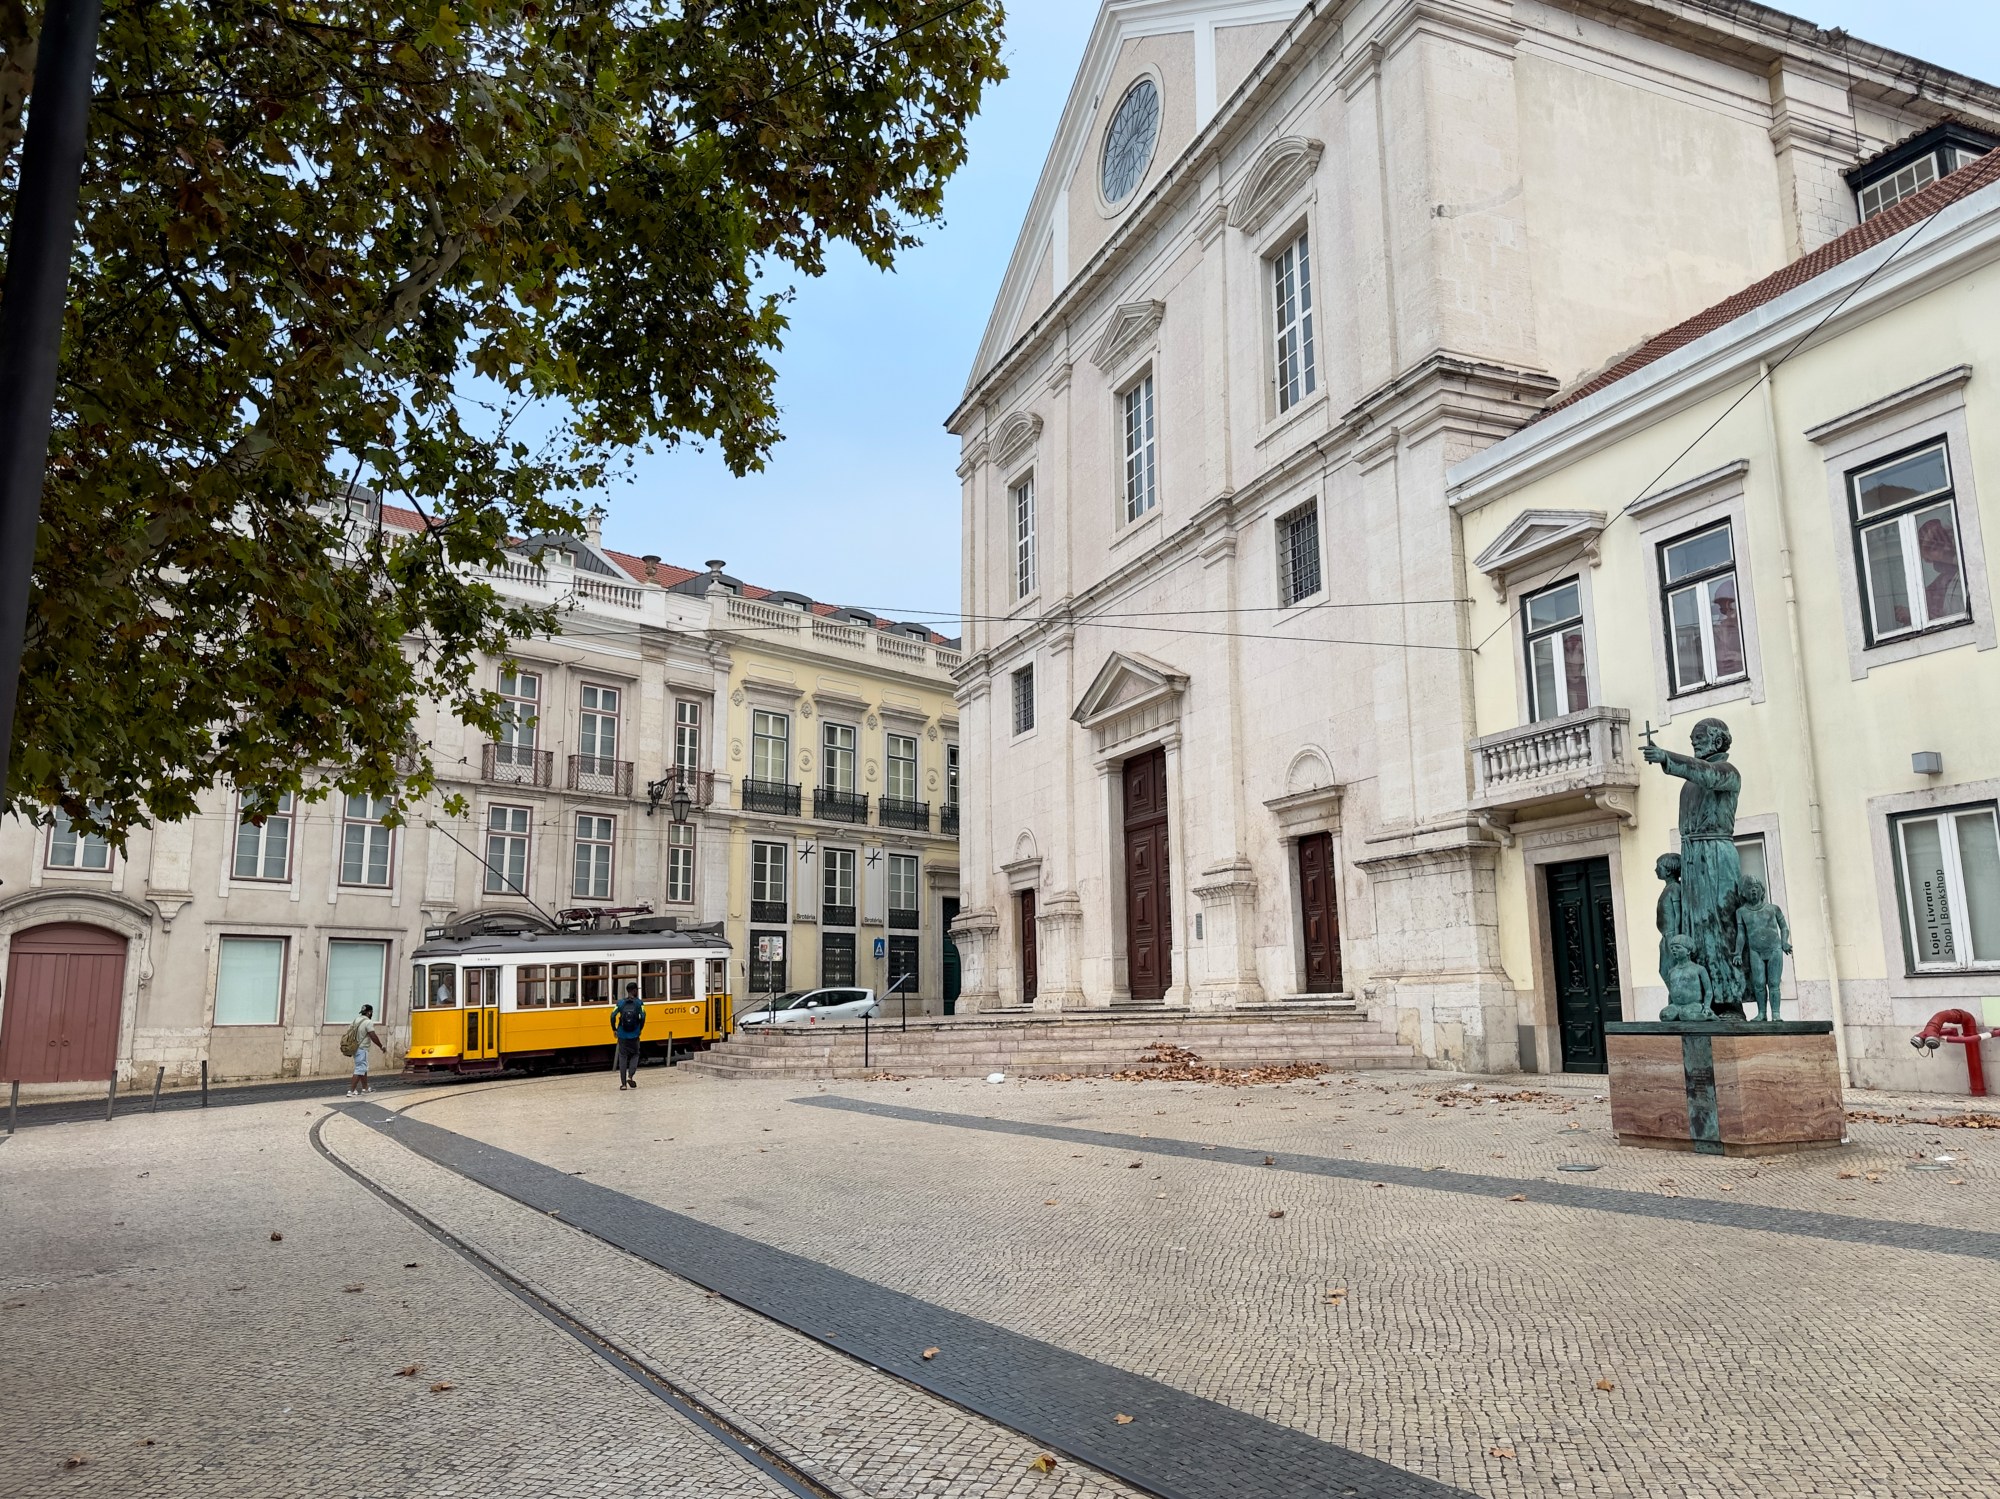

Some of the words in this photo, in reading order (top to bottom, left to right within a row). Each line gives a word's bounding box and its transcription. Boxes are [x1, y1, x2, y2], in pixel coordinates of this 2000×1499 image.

[1538, 827, 1599, 844] MUSEU
[1923, 881, 1936, 923] Livraria
[1935, 869, 1949, 920] Bookshop
[1929, 932, 1941, 955] Loja
[1944, 928, 1954, 955] Shop
[664, 1005, 687, 1015] carris
